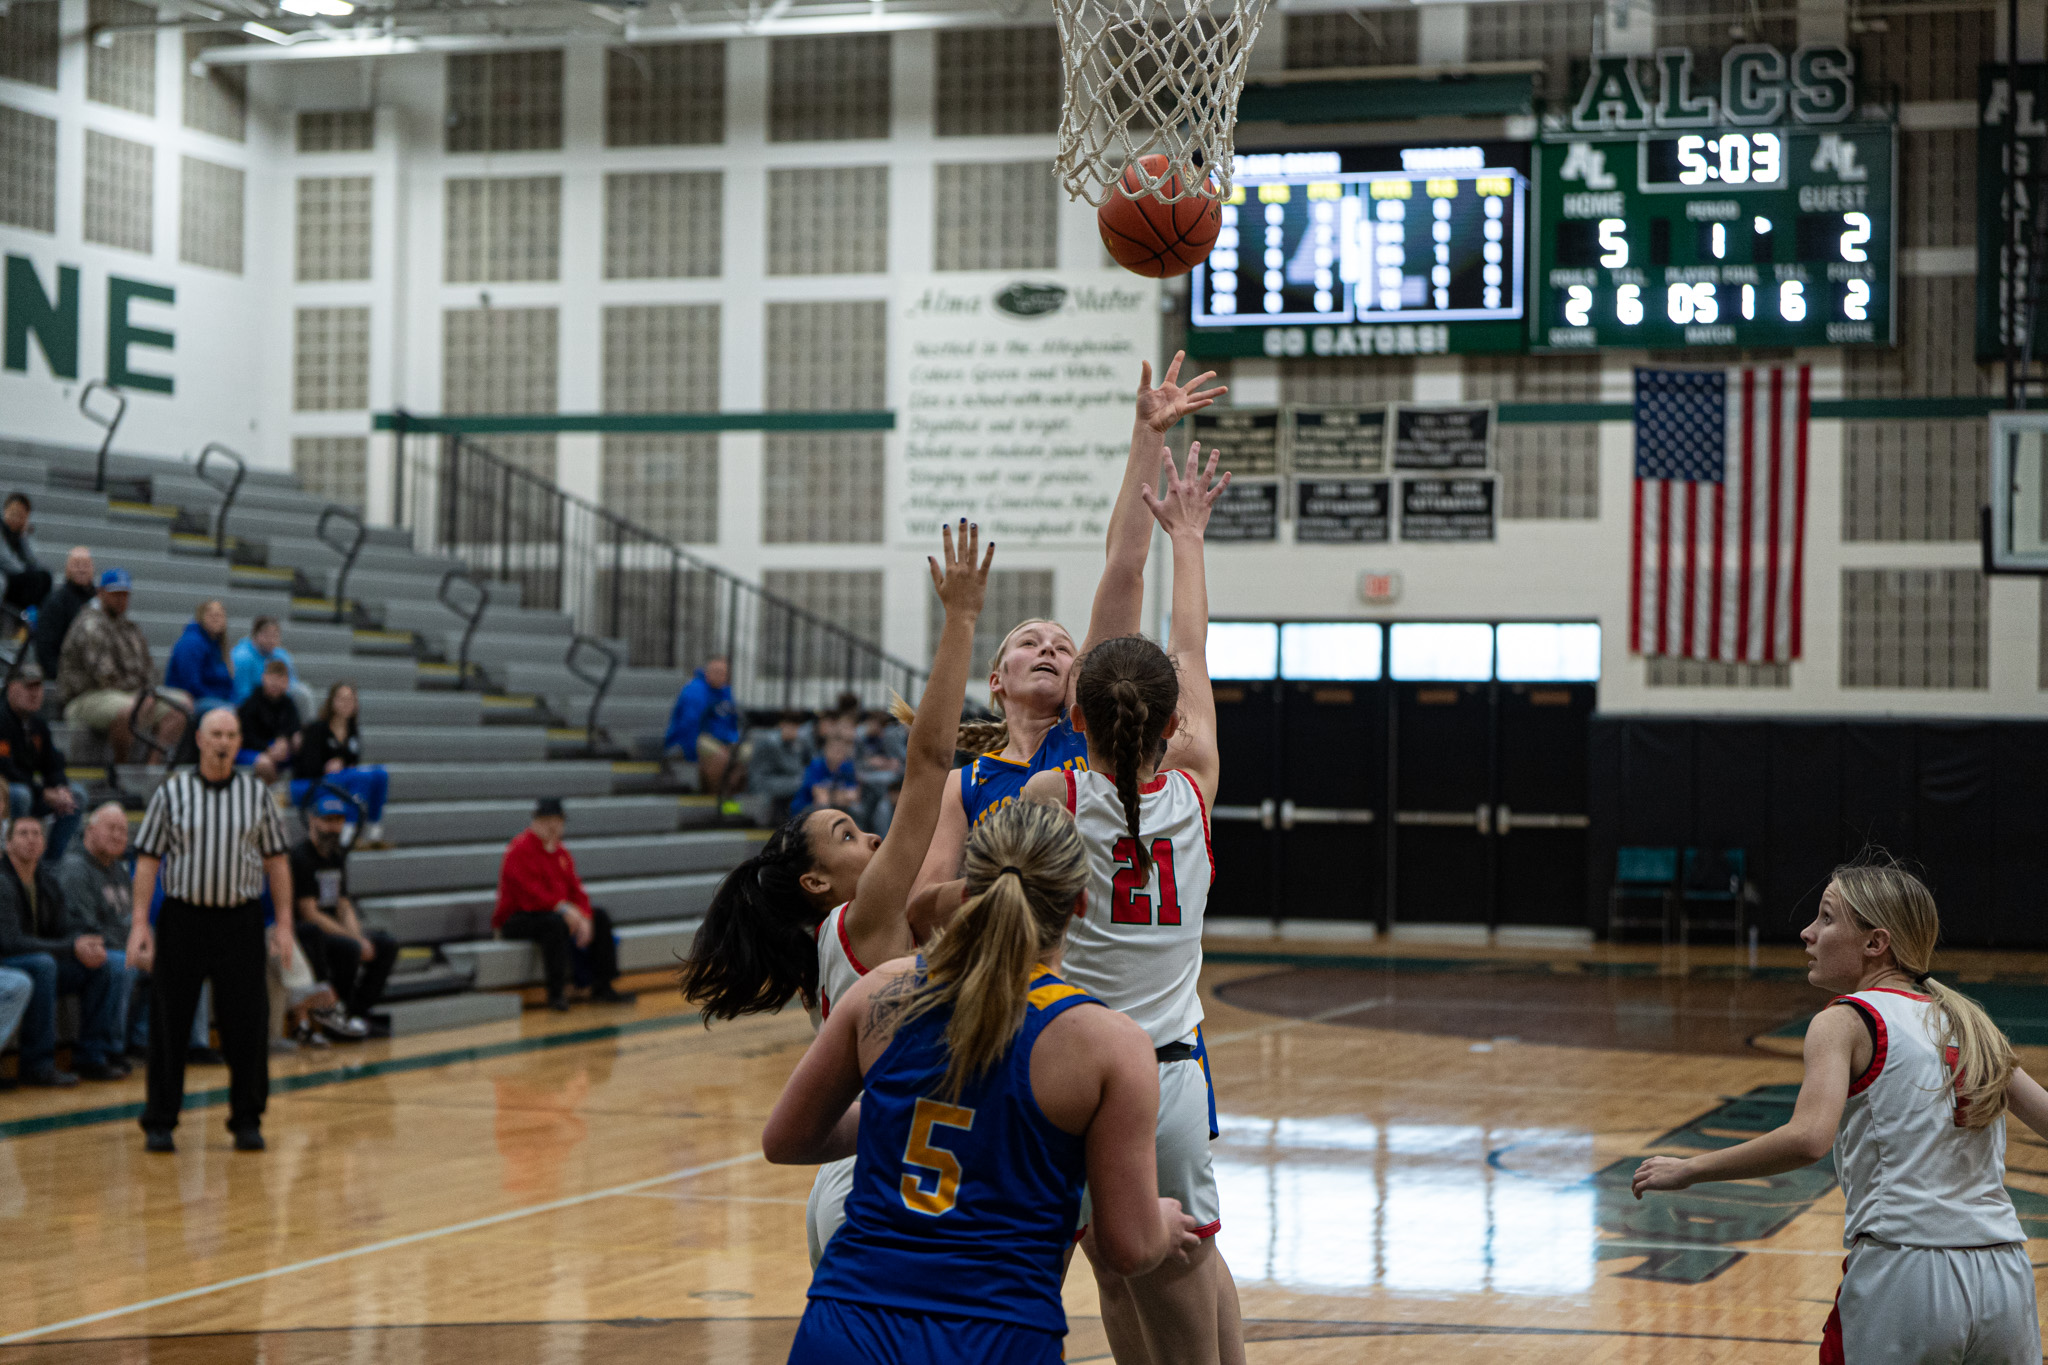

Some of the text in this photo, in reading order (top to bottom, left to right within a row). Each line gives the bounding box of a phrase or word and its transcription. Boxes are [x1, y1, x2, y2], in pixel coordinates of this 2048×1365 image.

[1572, 43, 1855, 131] ALCS
[1678, 133, 1781, 186] 5:03
[1799, 186, 1869, 212] GUEST
[1598, 218, 1629, 269] 5
[1711, 223, 1726, 259] 1
[1840, 212, 1871, 262] 2
[904, 288, 981, 318] Alma
[1565, 285, 1592, 326] 2
[1616, 284, 1644, 325] 6
[1741, 284, 1755, 320] 1
[1780, 280, 1806, 321] 6
[1844, 279, 1870, 320] 2
[1264, 324, 1449, 356] GO GATORS!
[1111, 837, 1181, 926] 21
[900, 1097, 976, 1217] 5
